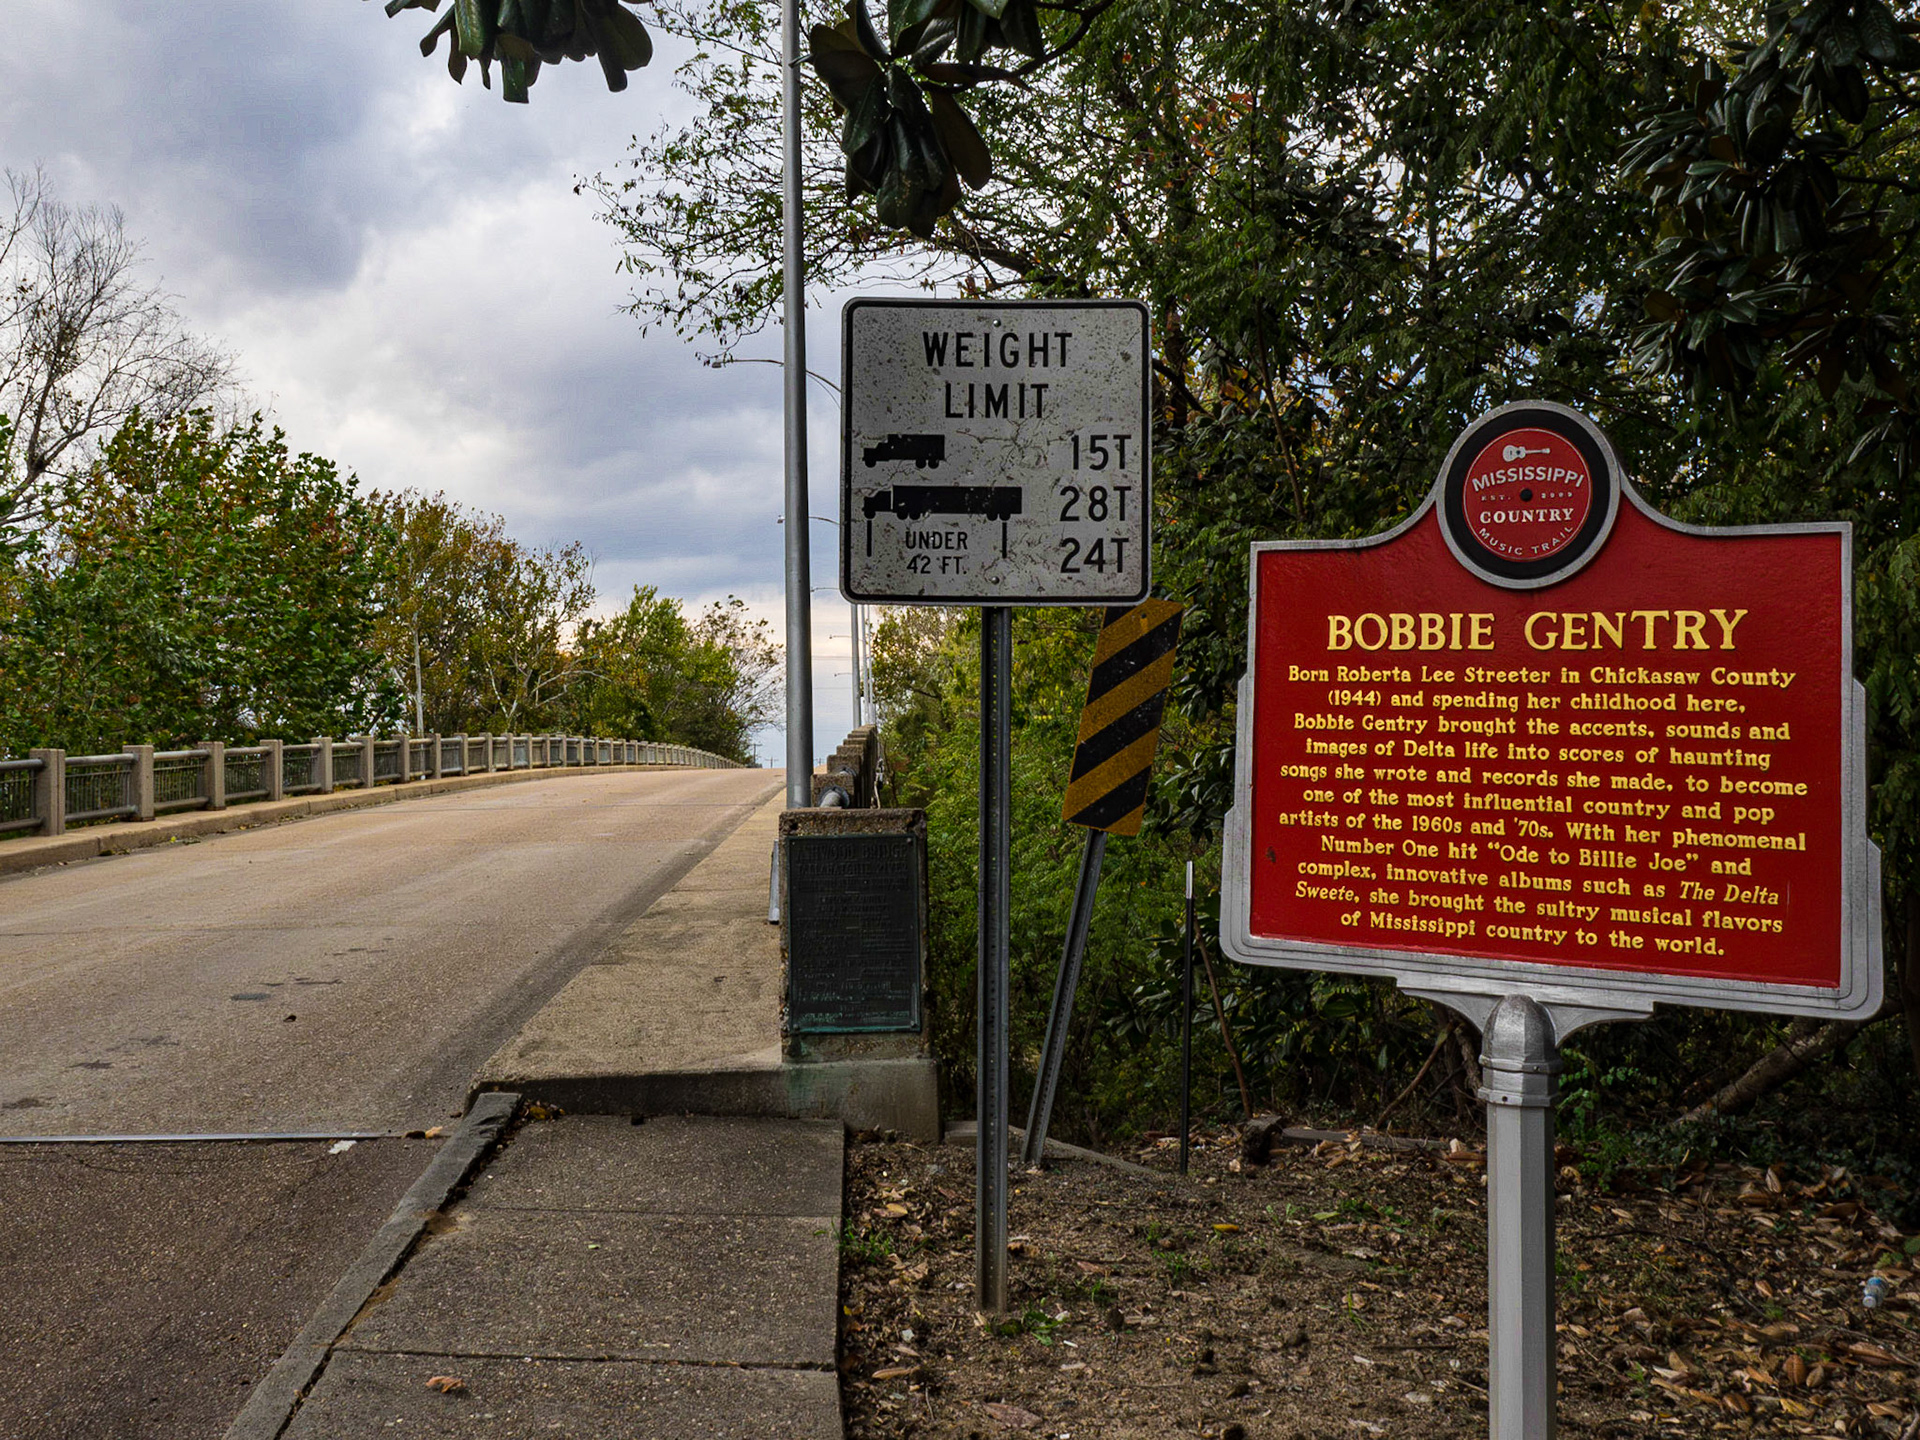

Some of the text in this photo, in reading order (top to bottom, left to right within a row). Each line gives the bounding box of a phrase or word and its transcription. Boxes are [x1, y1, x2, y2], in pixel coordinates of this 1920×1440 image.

[923, 332, 1073, 368] WEIGHT
[944, 383, 1049, 419] LIMIT
[1071, 434, 1132, 470] 15T
[1472, 466, 1584, 492] MISSISSIPPI
[1059, 485, 1132, 522] 28T
[1480, 508, 1574, 523] COUNTRY
[905, 531, 968, 550] UNDER
[1060, 537, 1129, 574] 24T
[1479, 526, 1574, 555] MUSIC TRAIL
[906, 556, 967, 575] 42 FT.
[1327, 609, 1748, 650] BOBBIE GENTRY
[1289, 665, 1796, 688] Born Roberta Lee Streeter in Chickasaw County
[1328, 690, 1745, 713] (1944) and spending her childhood here,
[1294, 713, 1790, 740] Bobbie Gentry brought the accents, sounds and
[1306, 738, 1771, 771] images of Delta life into scores of haunting
[1281, 763, 1807, 795] songs she wrote and records she made, to become
[1303, 788, 1774, 825] one of the most influential country and pop
[1280, 810, 1338, 827] artists
[1346, 813, 1366, 828] of
[1372, 814, 1402, 830] the
[1413, 816, 1462, 833] 1960s
[1471, 819, 1505, 835] and
[1566, 822, 1615, 841] With
[1625, 825, 1660, 843] her
[1673, 828, 1806, 850] phenomenal
[1321, 835, 1394, 854] Number
[1403, 840, 1438, 857] One
[1448, 842, 1477, 859] hit
[1548, 848, 1570, 864] to
[1579, 849, 1636, 868] Billie
[1711, 858, 1751, 875] and
[1298, 860, 1778, 904] complex, innovative albums such as The Delta
[1296, 881, 1782, 932] Sweete, she brought the sultry musical flavors
[1341, 911, 1724, 955] of Mississippi country to the world.
